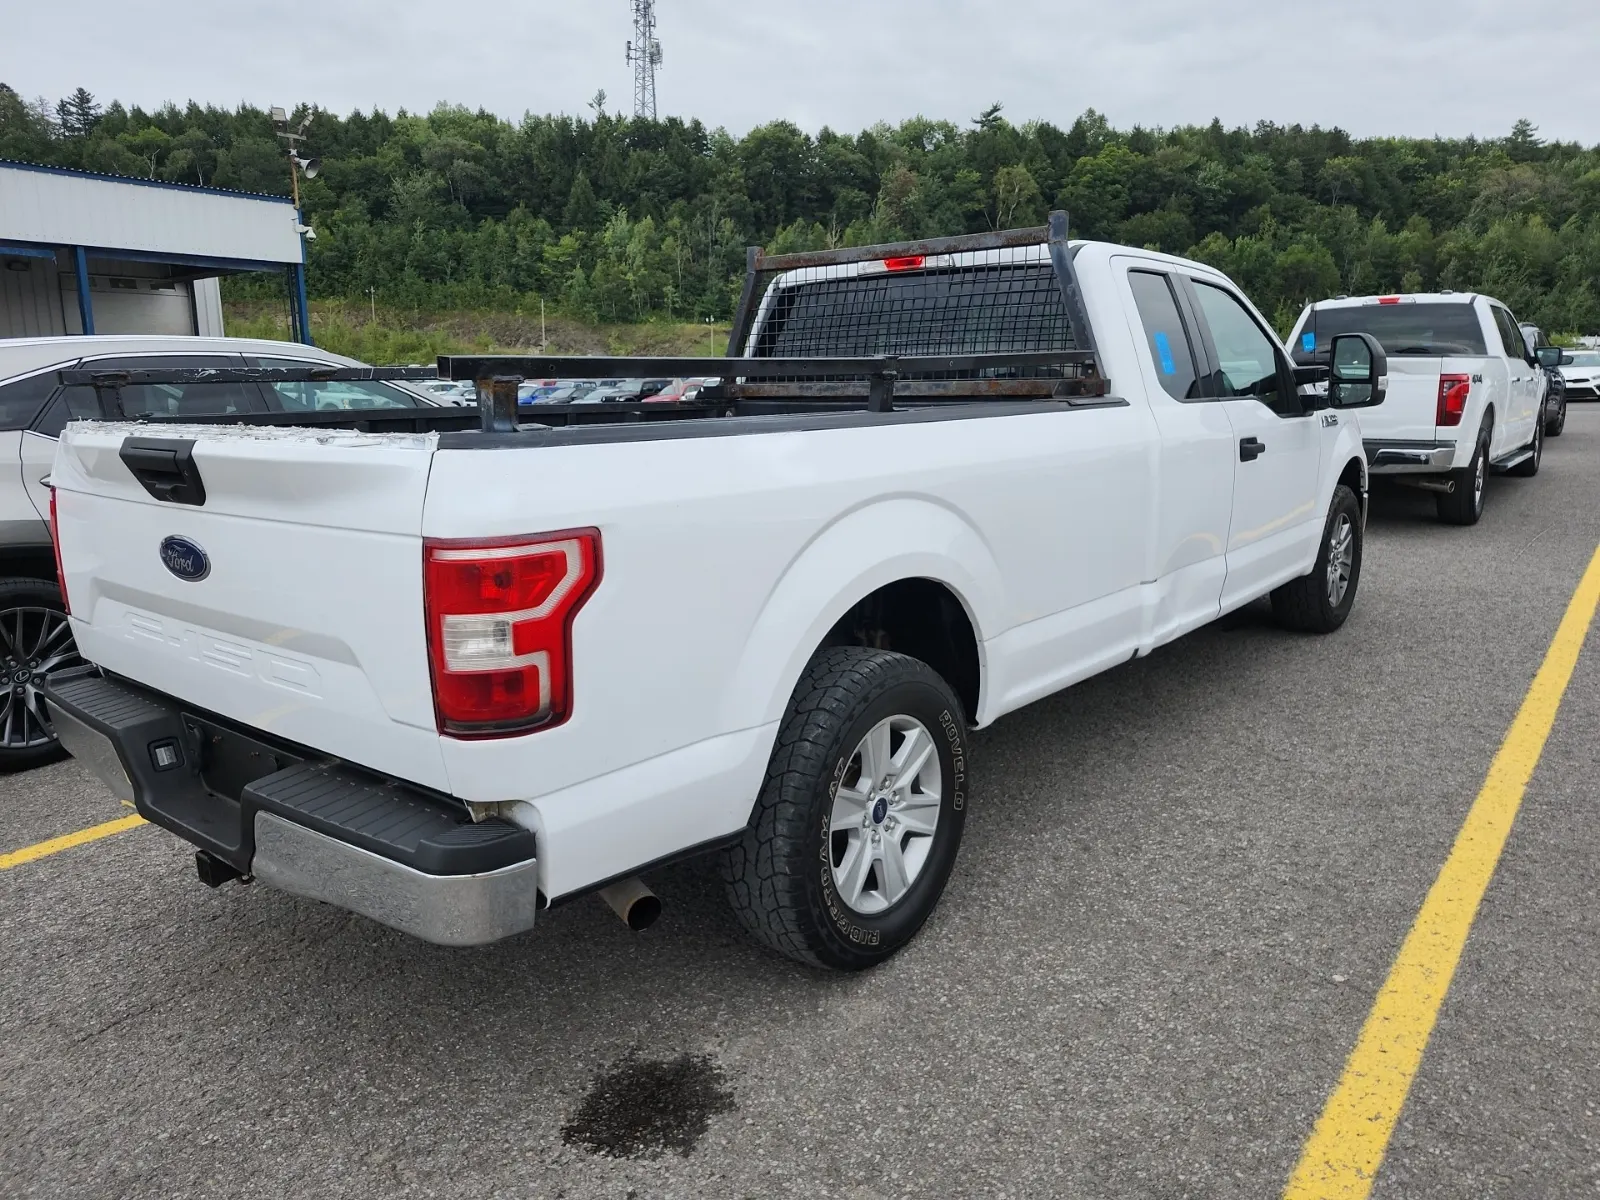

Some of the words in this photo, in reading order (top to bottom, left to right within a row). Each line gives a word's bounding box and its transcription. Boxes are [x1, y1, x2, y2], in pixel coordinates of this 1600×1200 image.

[167, 544, 195, 573] Ford
[938, 709, 964, 811] ROVELO
[819, 813, 880, 946] RIDGETRAK
